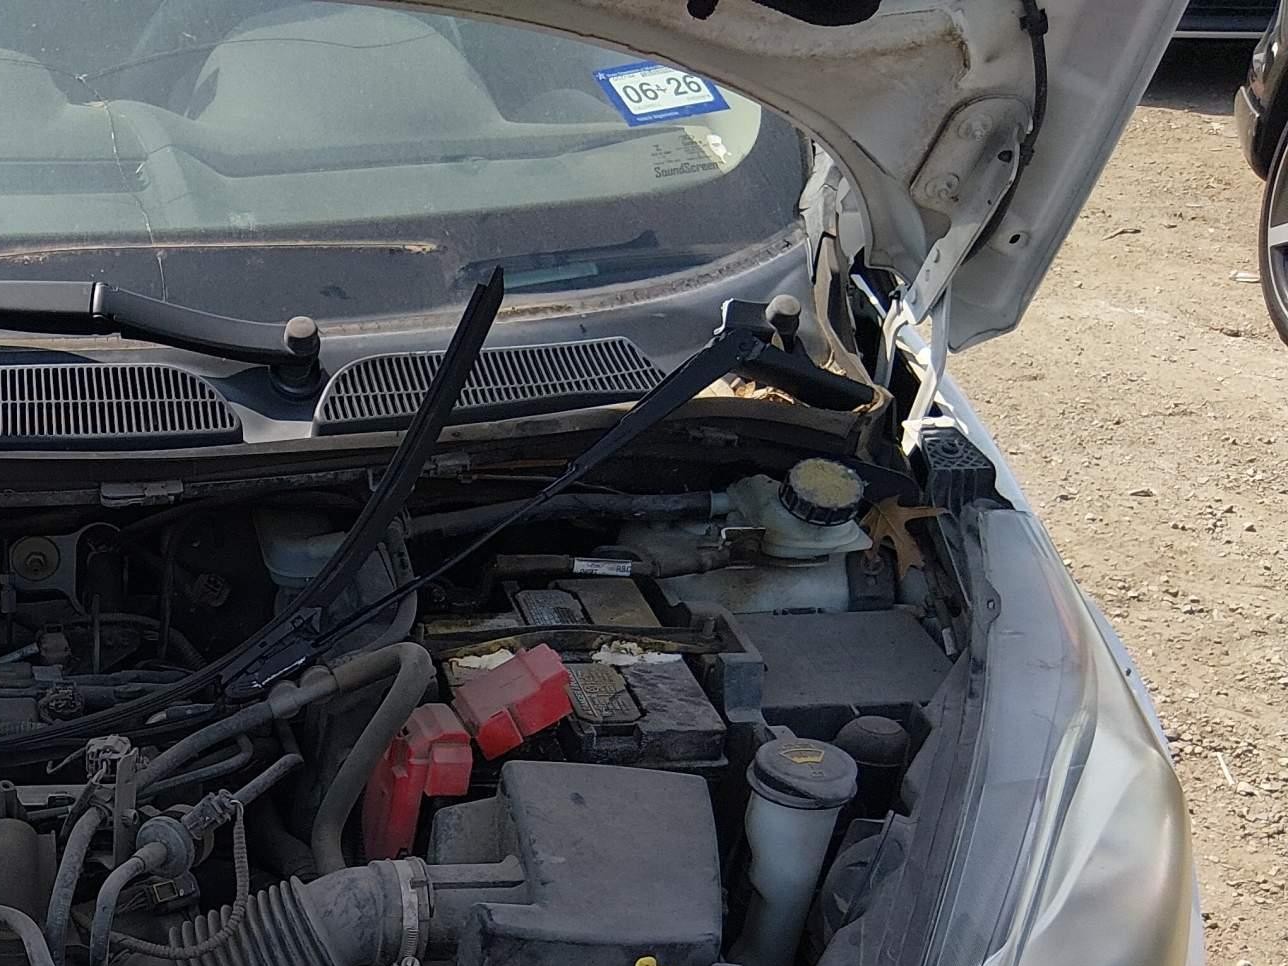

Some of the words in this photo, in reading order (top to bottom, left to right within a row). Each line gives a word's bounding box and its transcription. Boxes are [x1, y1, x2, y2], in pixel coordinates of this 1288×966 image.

[622, 82, 659, 104] 06
[666, 74, 702, 97] 26
[654, 162, 718, 178] SoundScreen
